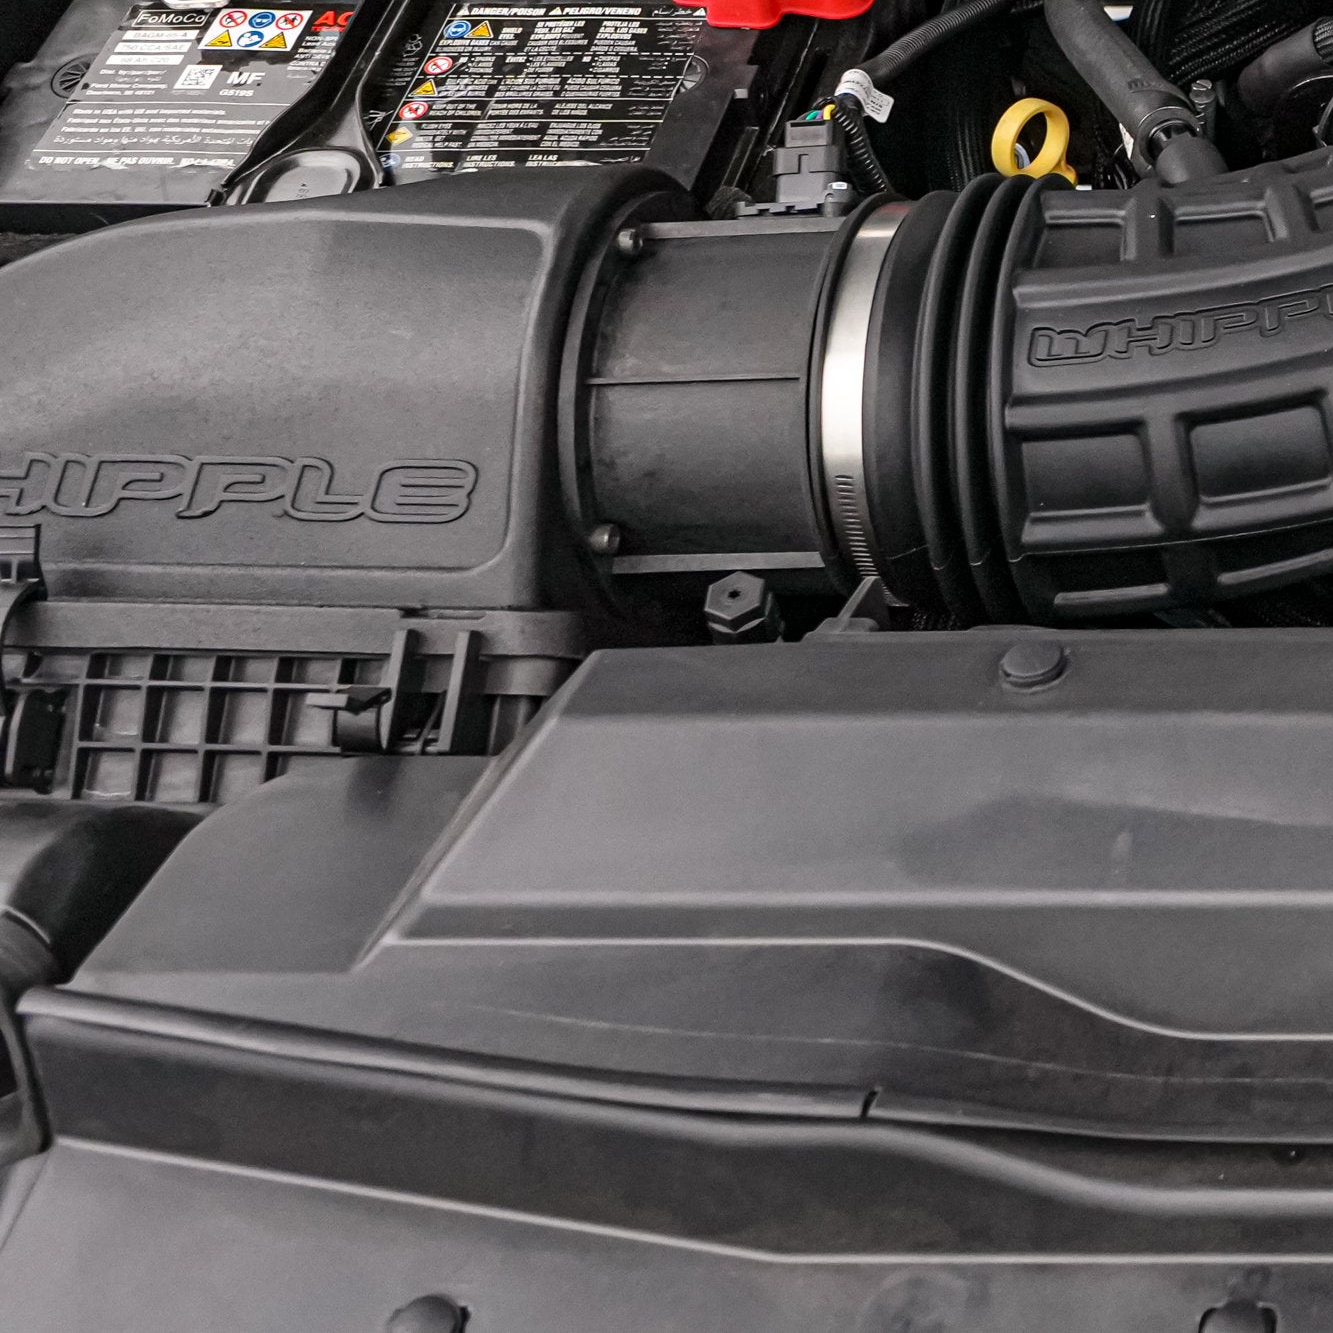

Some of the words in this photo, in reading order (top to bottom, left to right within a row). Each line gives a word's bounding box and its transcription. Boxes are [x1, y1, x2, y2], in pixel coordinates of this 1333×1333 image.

[471, 8, 546, 16] DANGER/POISON
[563, 8, 642, 16] PELIGRO/VENENO
[137, 13, 205, 24] FoMoCo
